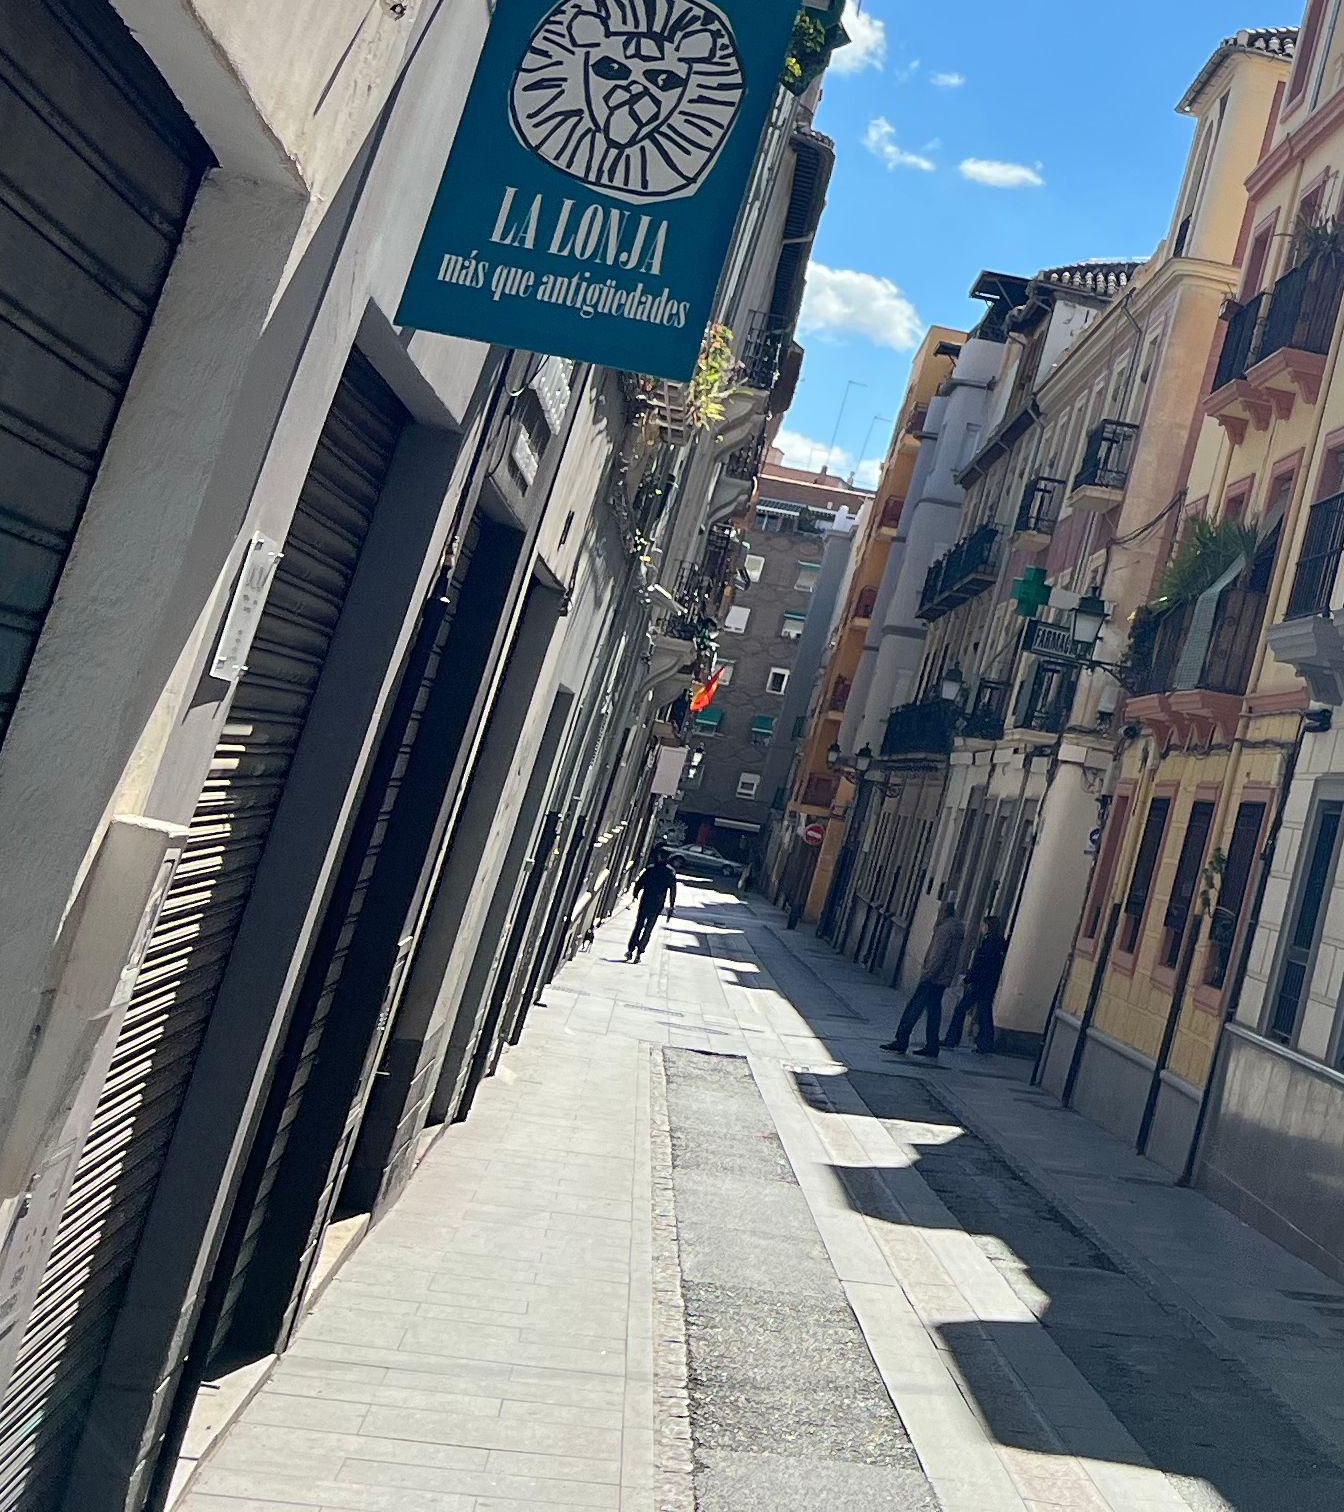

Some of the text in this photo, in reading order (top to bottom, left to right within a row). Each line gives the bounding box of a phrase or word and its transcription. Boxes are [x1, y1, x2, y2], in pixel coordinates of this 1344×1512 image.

[489, 185, 669, 276] LA LONJA
[437, 250, 690, 329] más que antigüedades
